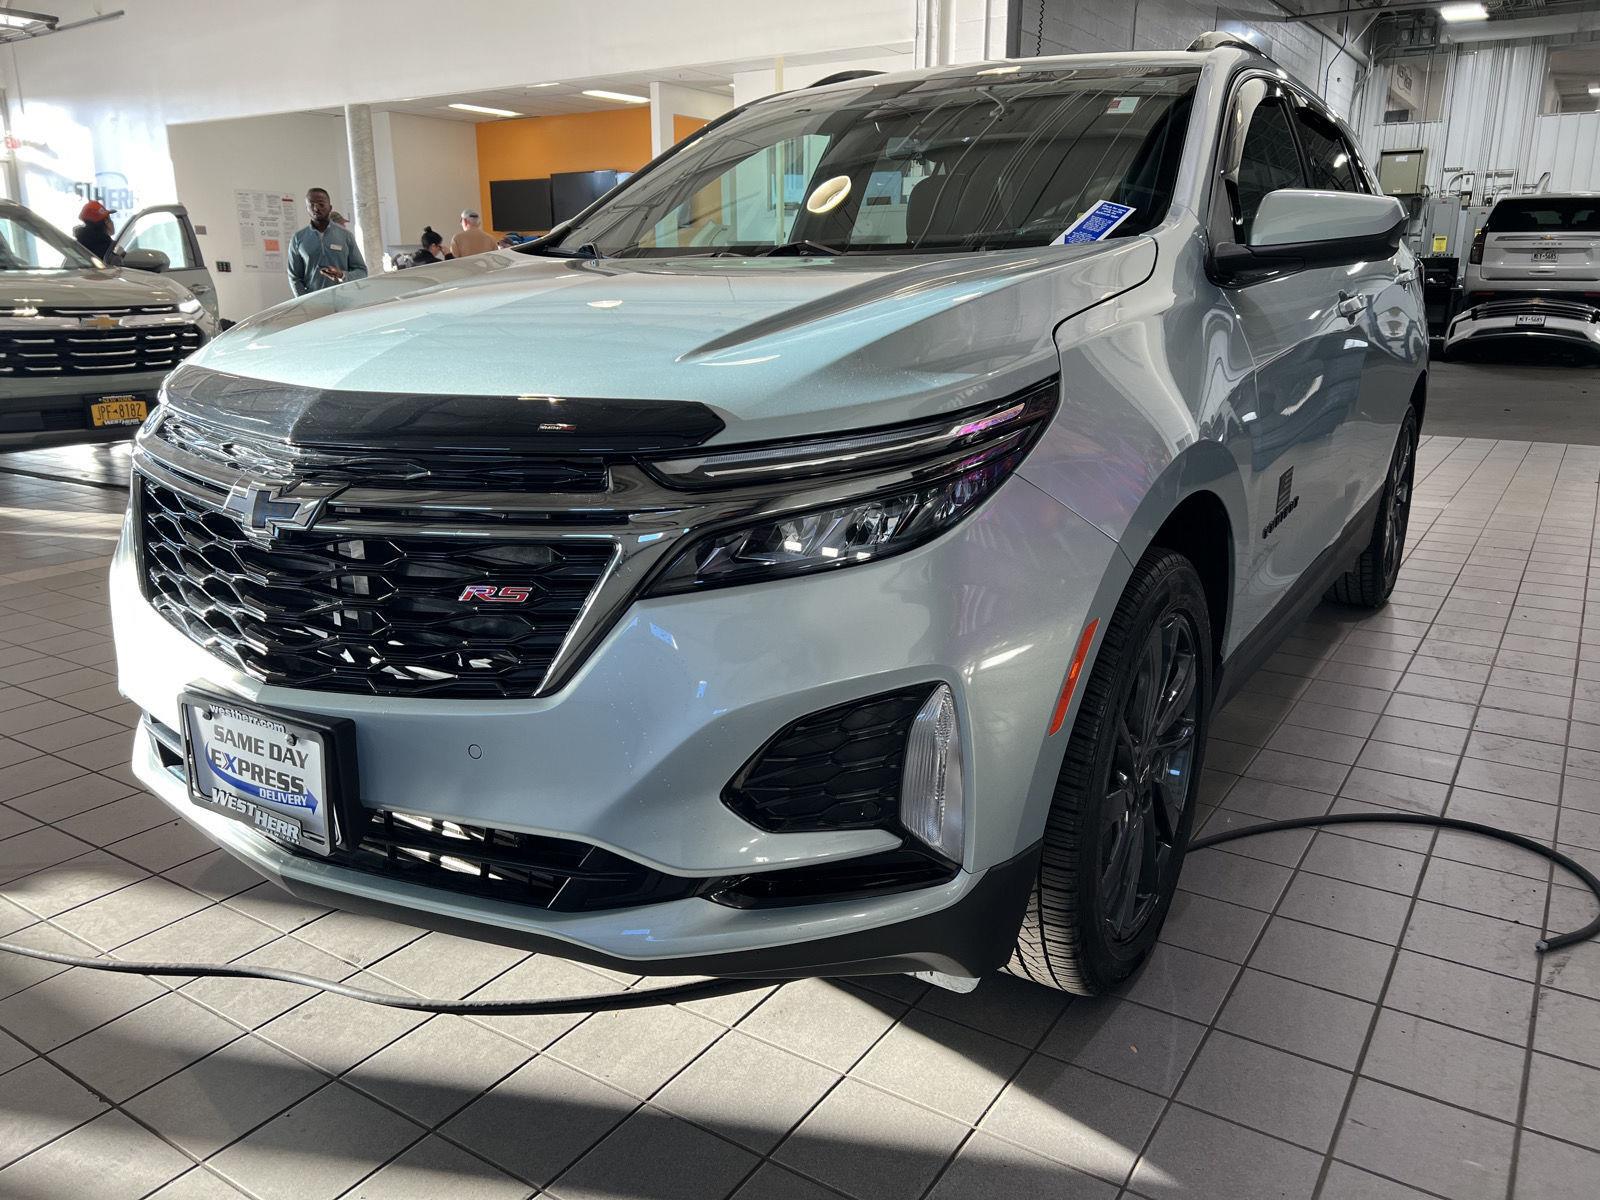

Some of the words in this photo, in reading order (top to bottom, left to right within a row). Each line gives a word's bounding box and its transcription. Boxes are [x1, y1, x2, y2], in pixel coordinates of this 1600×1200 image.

[458, 585, 533, 602] RS
[209, 704, 286, 733] westherr.com
[213, 724, 265, 757] SAME
[269, 742, 309, 770] DAY
[210, 748, 305, 796] EXPRESS
[259, 787, 308, 807] DELIVERY
